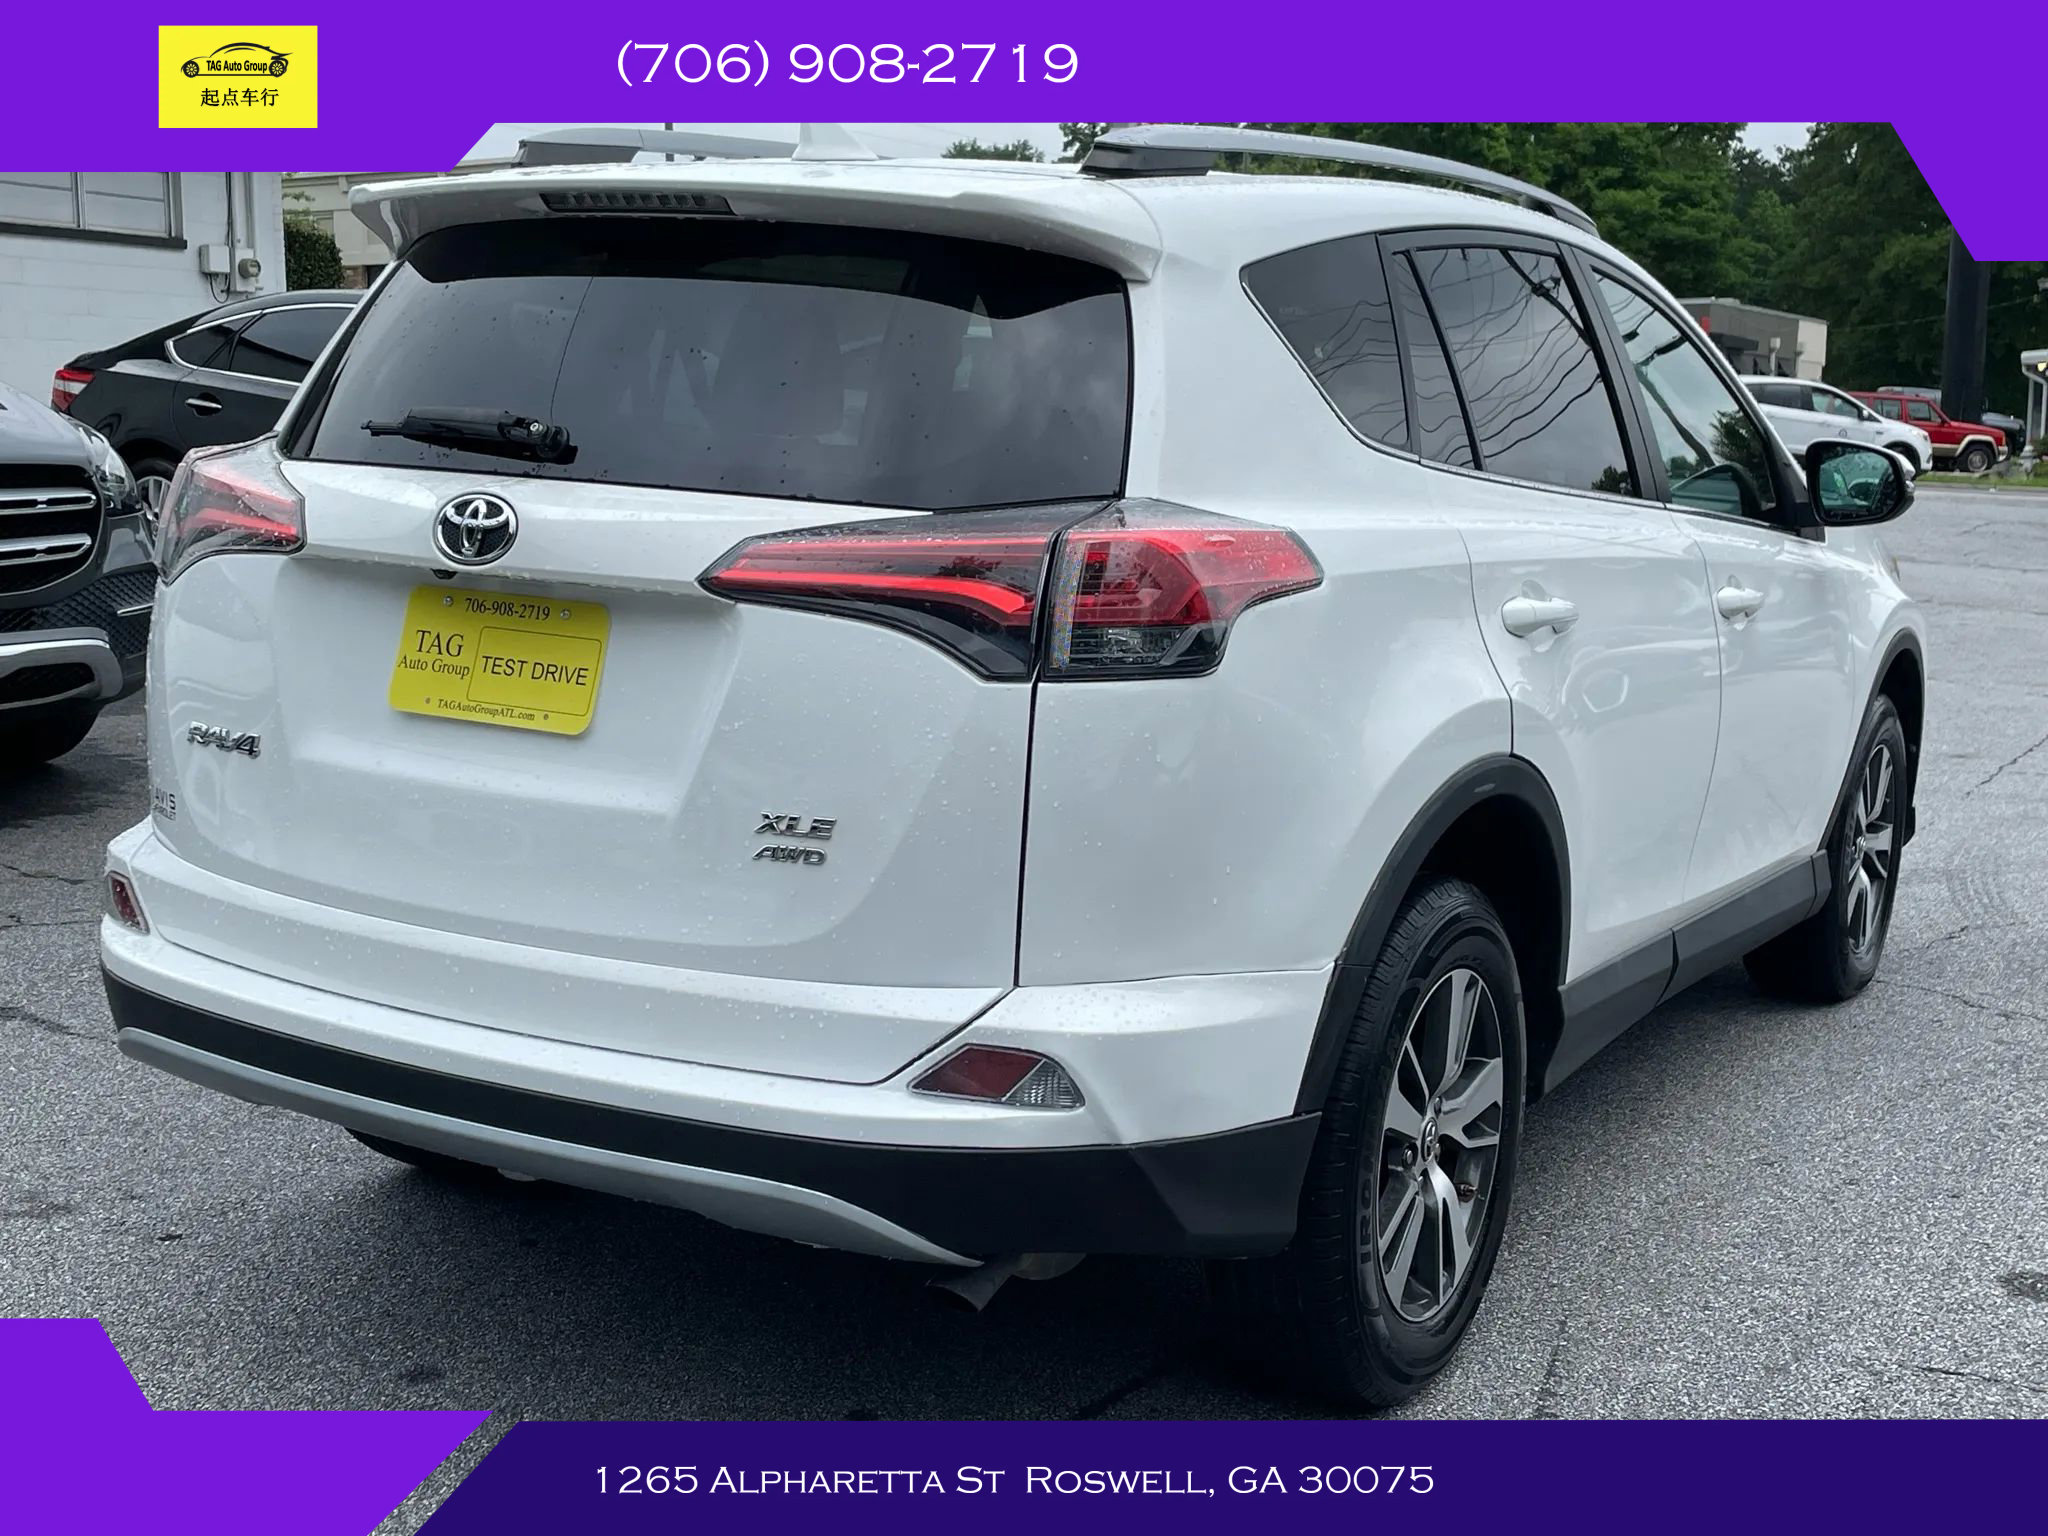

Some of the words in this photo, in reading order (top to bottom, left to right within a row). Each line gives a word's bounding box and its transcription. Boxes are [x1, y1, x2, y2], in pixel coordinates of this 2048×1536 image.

[464, 597, 551, 621] 706-908-2719
[416, 629, 464, 658] TAG
[398, 654, 429, 672] Auto
[431, 658, 471, 680] Group
[481, 655, 529, 679] TEST
[531, 661, 590, 686] DRIVE
[437, 698, 536, 722] TAGAutoGroupATL.com
[187, 720, 261, 760] RAV4
[753, 811, 837, 840] XLE
[752, 844, 828, 866] AWD
